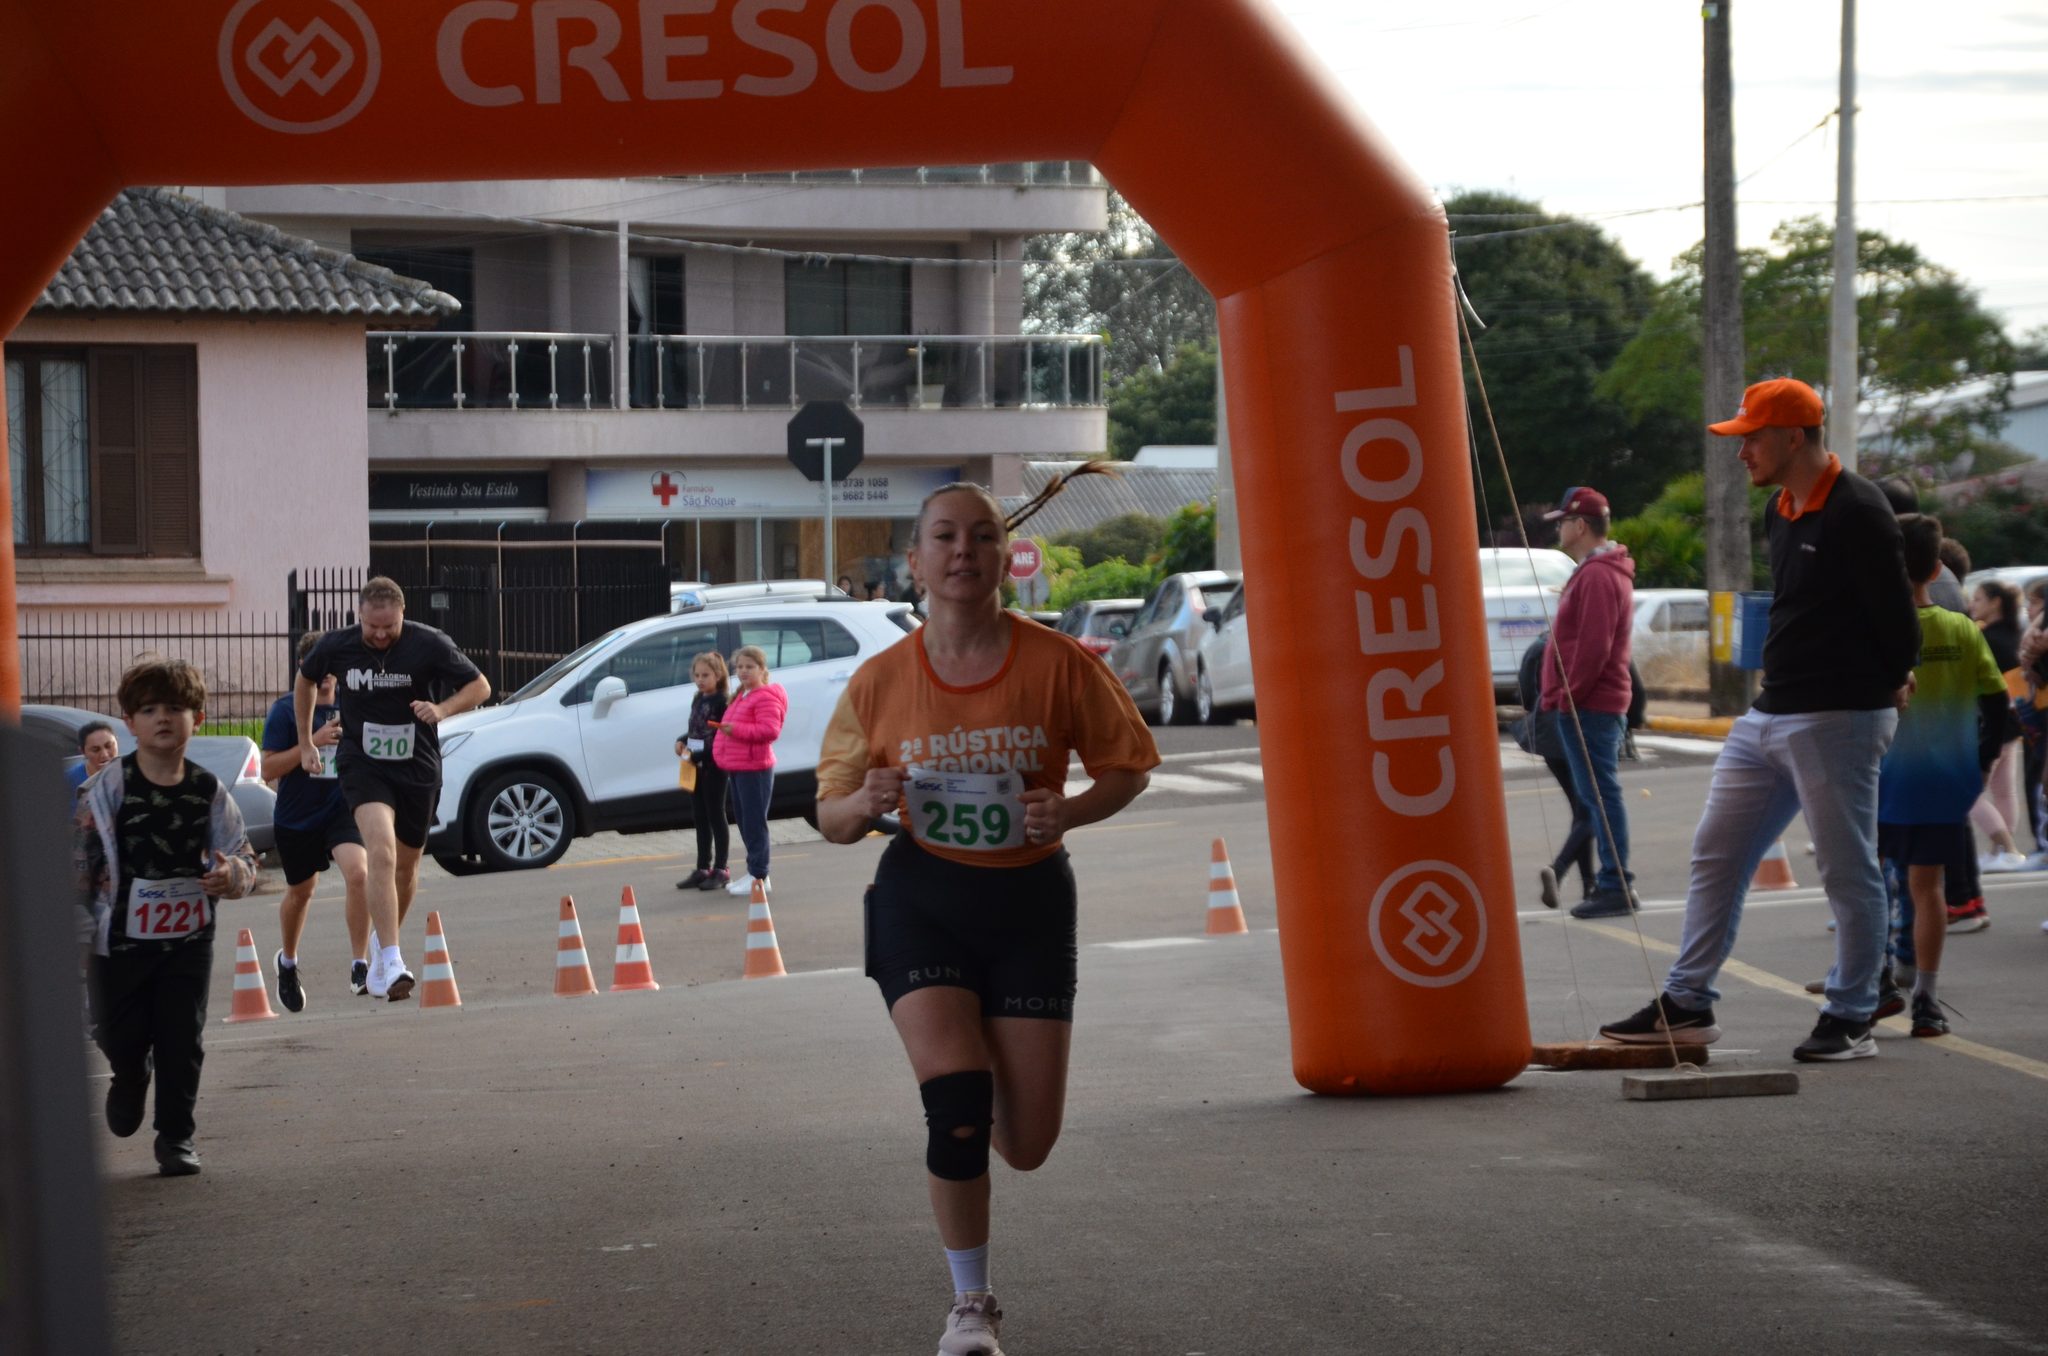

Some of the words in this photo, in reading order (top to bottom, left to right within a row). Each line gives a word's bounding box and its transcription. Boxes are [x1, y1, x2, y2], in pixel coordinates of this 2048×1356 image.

[436, 0, 1014, 107] CRESOL
[409, 483, 457, 497] Vestindo
[460, 482, 482, 496] Seu
[486, 482, 518, 496] Estilo
[682, 495, 701, 507] São
[704, 496, 736, 508] Roque
[1334, 345, 1456, 817] CRESOL
[369, 737, 408, 757] 210
[900, 737, 922, 762] 2ª
[930, 725, 1049, 757] RÚSTICA
[922, 801, 1010, 846] 259
[135, 898, 206, 934] 1221
[908, 966, 961, 983] RUN
